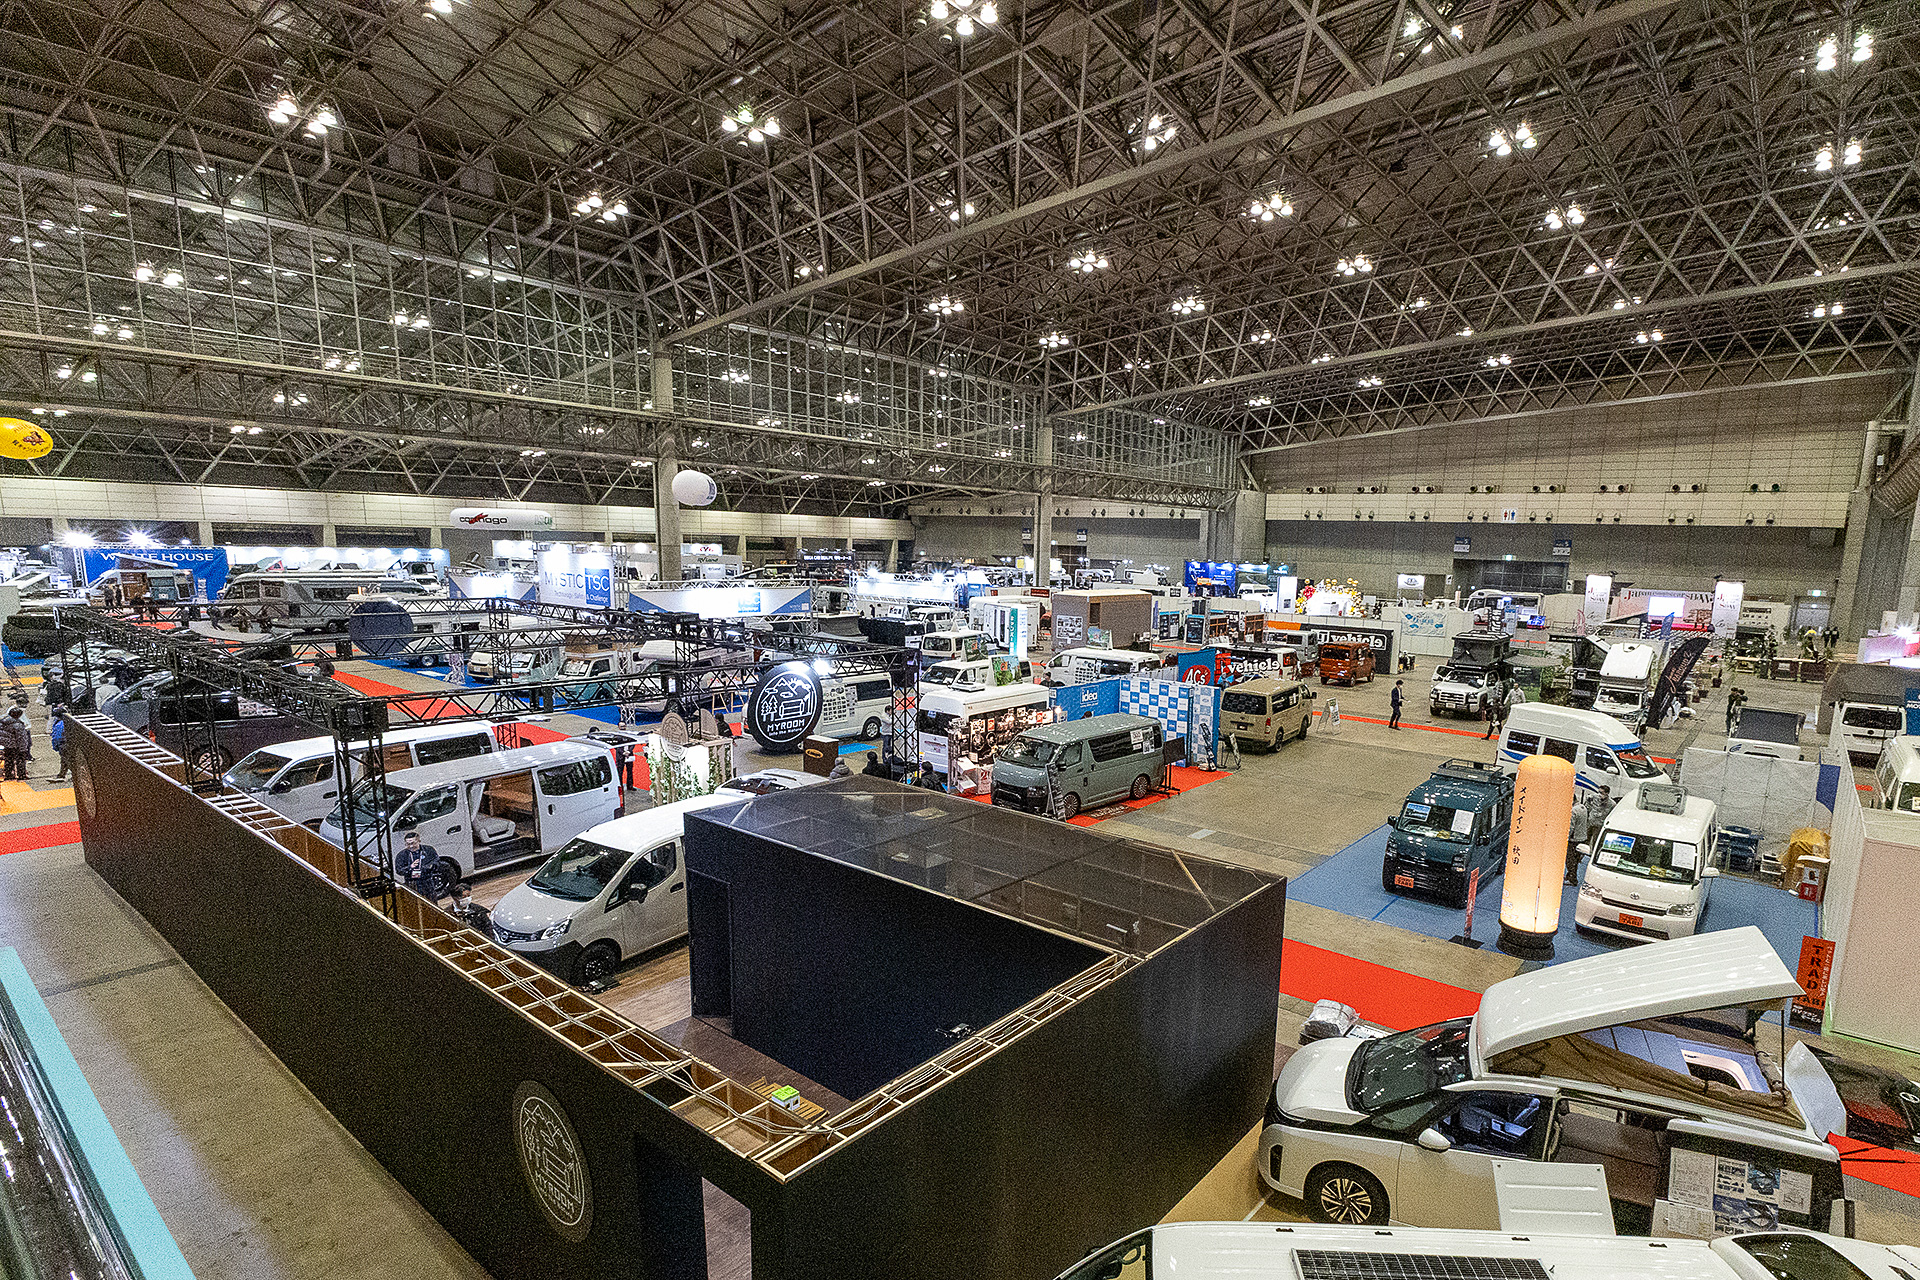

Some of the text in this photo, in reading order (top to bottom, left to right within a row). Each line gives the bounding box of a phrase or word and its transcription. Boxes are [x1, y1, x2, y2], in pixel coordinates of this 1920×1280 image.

[100, 553, 204, 561] WTE HOUSE
[585, 574, 609, 591] TSC
[1228, 658, 1280, 674] vehicle
[1082, 690, 1098, 702] idea
[767, 719, 805, 732] MYROOM
[1515, 786, 1527, 834] メイドイン
[1806, 944, 1824, 990] TRAD
